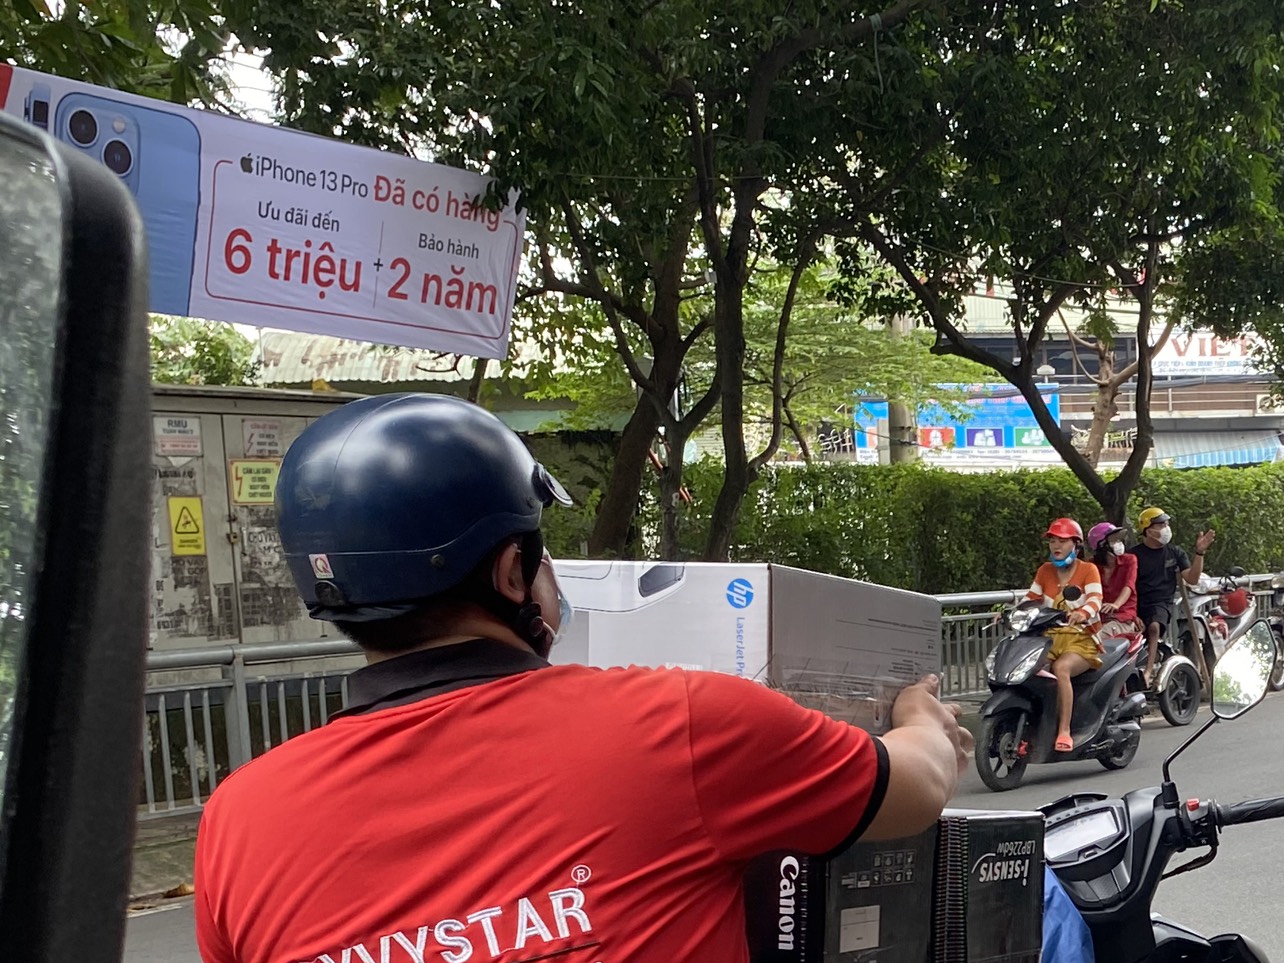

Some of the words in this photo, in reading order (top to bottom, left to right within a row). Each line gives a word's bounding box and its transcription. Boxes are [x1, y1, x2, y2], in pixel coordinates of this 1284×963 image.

[255, 155, 317, 187] iPhone
[320, 169, 338, 192] 13
[340, 174, 369, 198] Pro
[373, 174, 406, 207] Đã
[412, 185, 440, 214] có
[257, 200, 281, 221] Ưu
[284, 206, 309, 227] đãi
[311, 210, 341, 232] đến
[418, 232, 444, 252] Bảo
[446, 238, 480, 260] hành
[224, 227, 254, 276] 6
[266, 238, 363, 300] triệu
[387, 257, 411, 301] 2
[420, 264, 497, 316] năm
[167, 419, 188, 428] RMU
[726, 578, 755, 609] hp
[735, 616, 747, 660] LaserJet
[978, 858, 1030, 887] i-SENSYS
[777, 855, 801, 951] Canon
